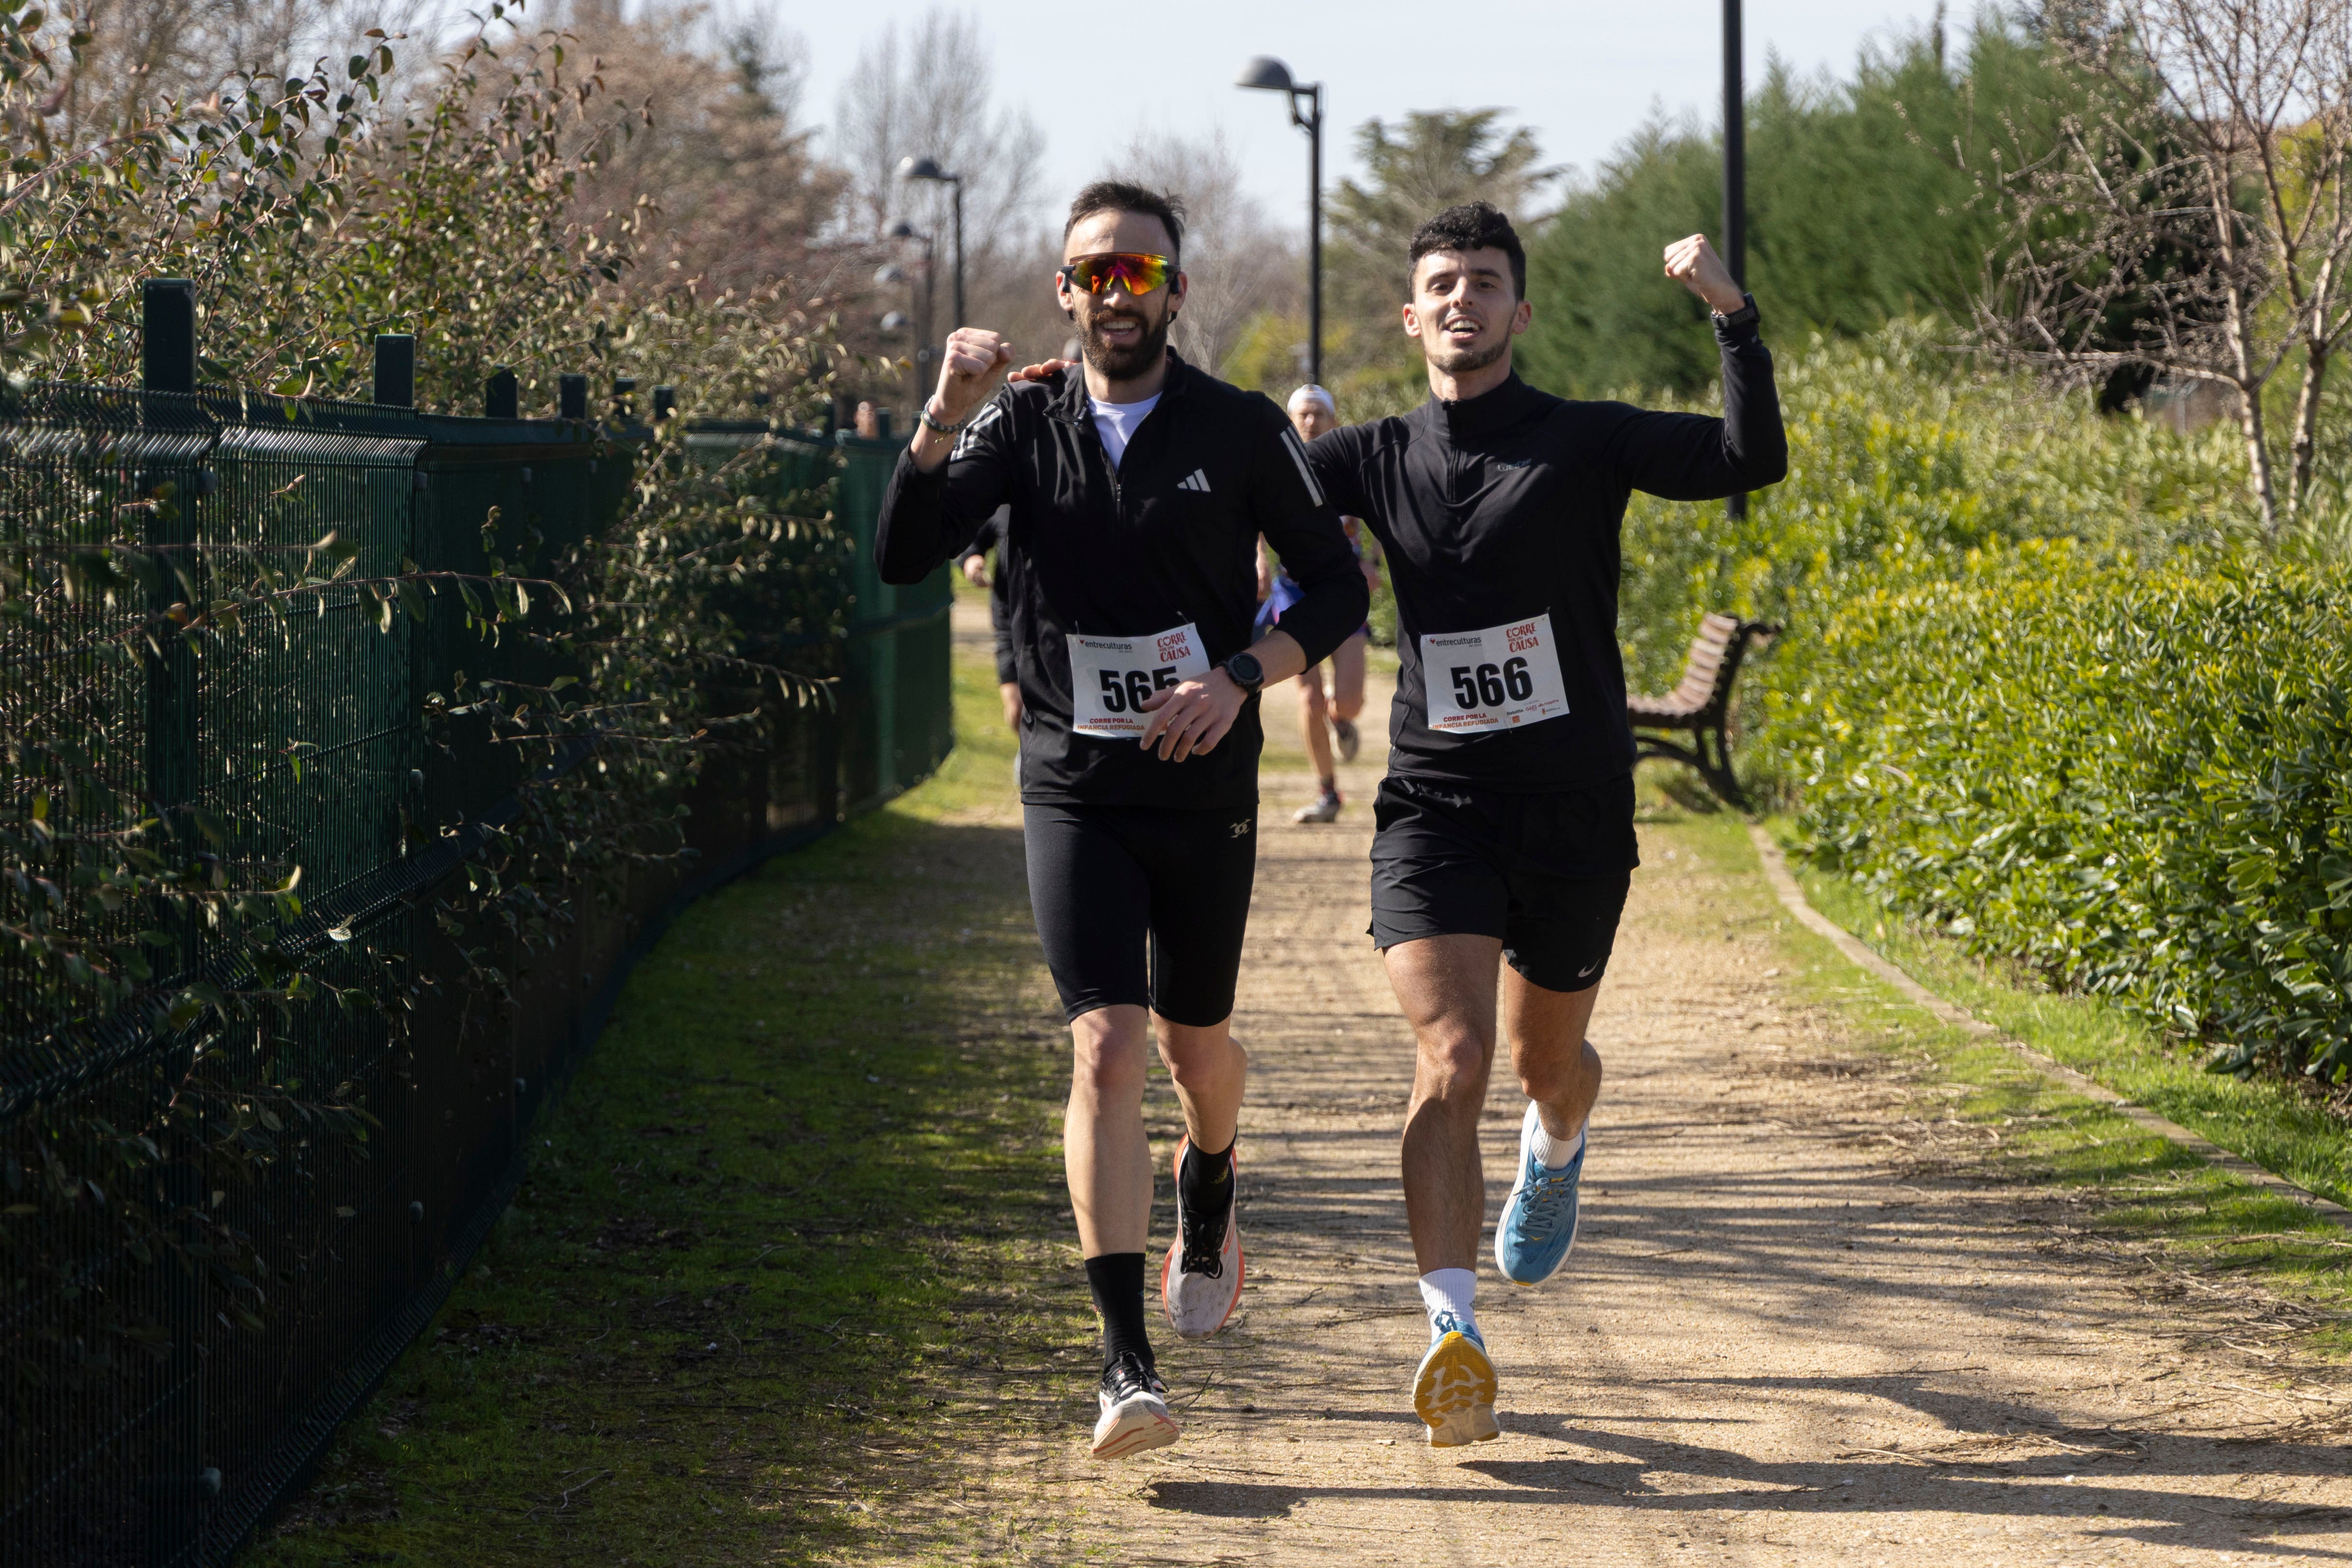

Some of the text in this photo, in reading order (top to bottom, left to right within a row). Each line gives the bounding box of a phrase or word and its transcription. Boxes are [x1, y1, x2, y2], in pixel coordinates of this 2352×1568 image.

[1506, 622, 1537, 638] CORRE
[1085, 641, 1132, 650] entreculturas
[1157, 631, 1187, 648] CORRE
[1436, 637, 1481, 646] entreculturas
[1510, 636, 1539, 652] CAUSA
[1160, 646, 1191, 662] CAUSA
[1450, 656, 1533, 709] 566
[1463, 718, 1499, 727] REFUGIADA
